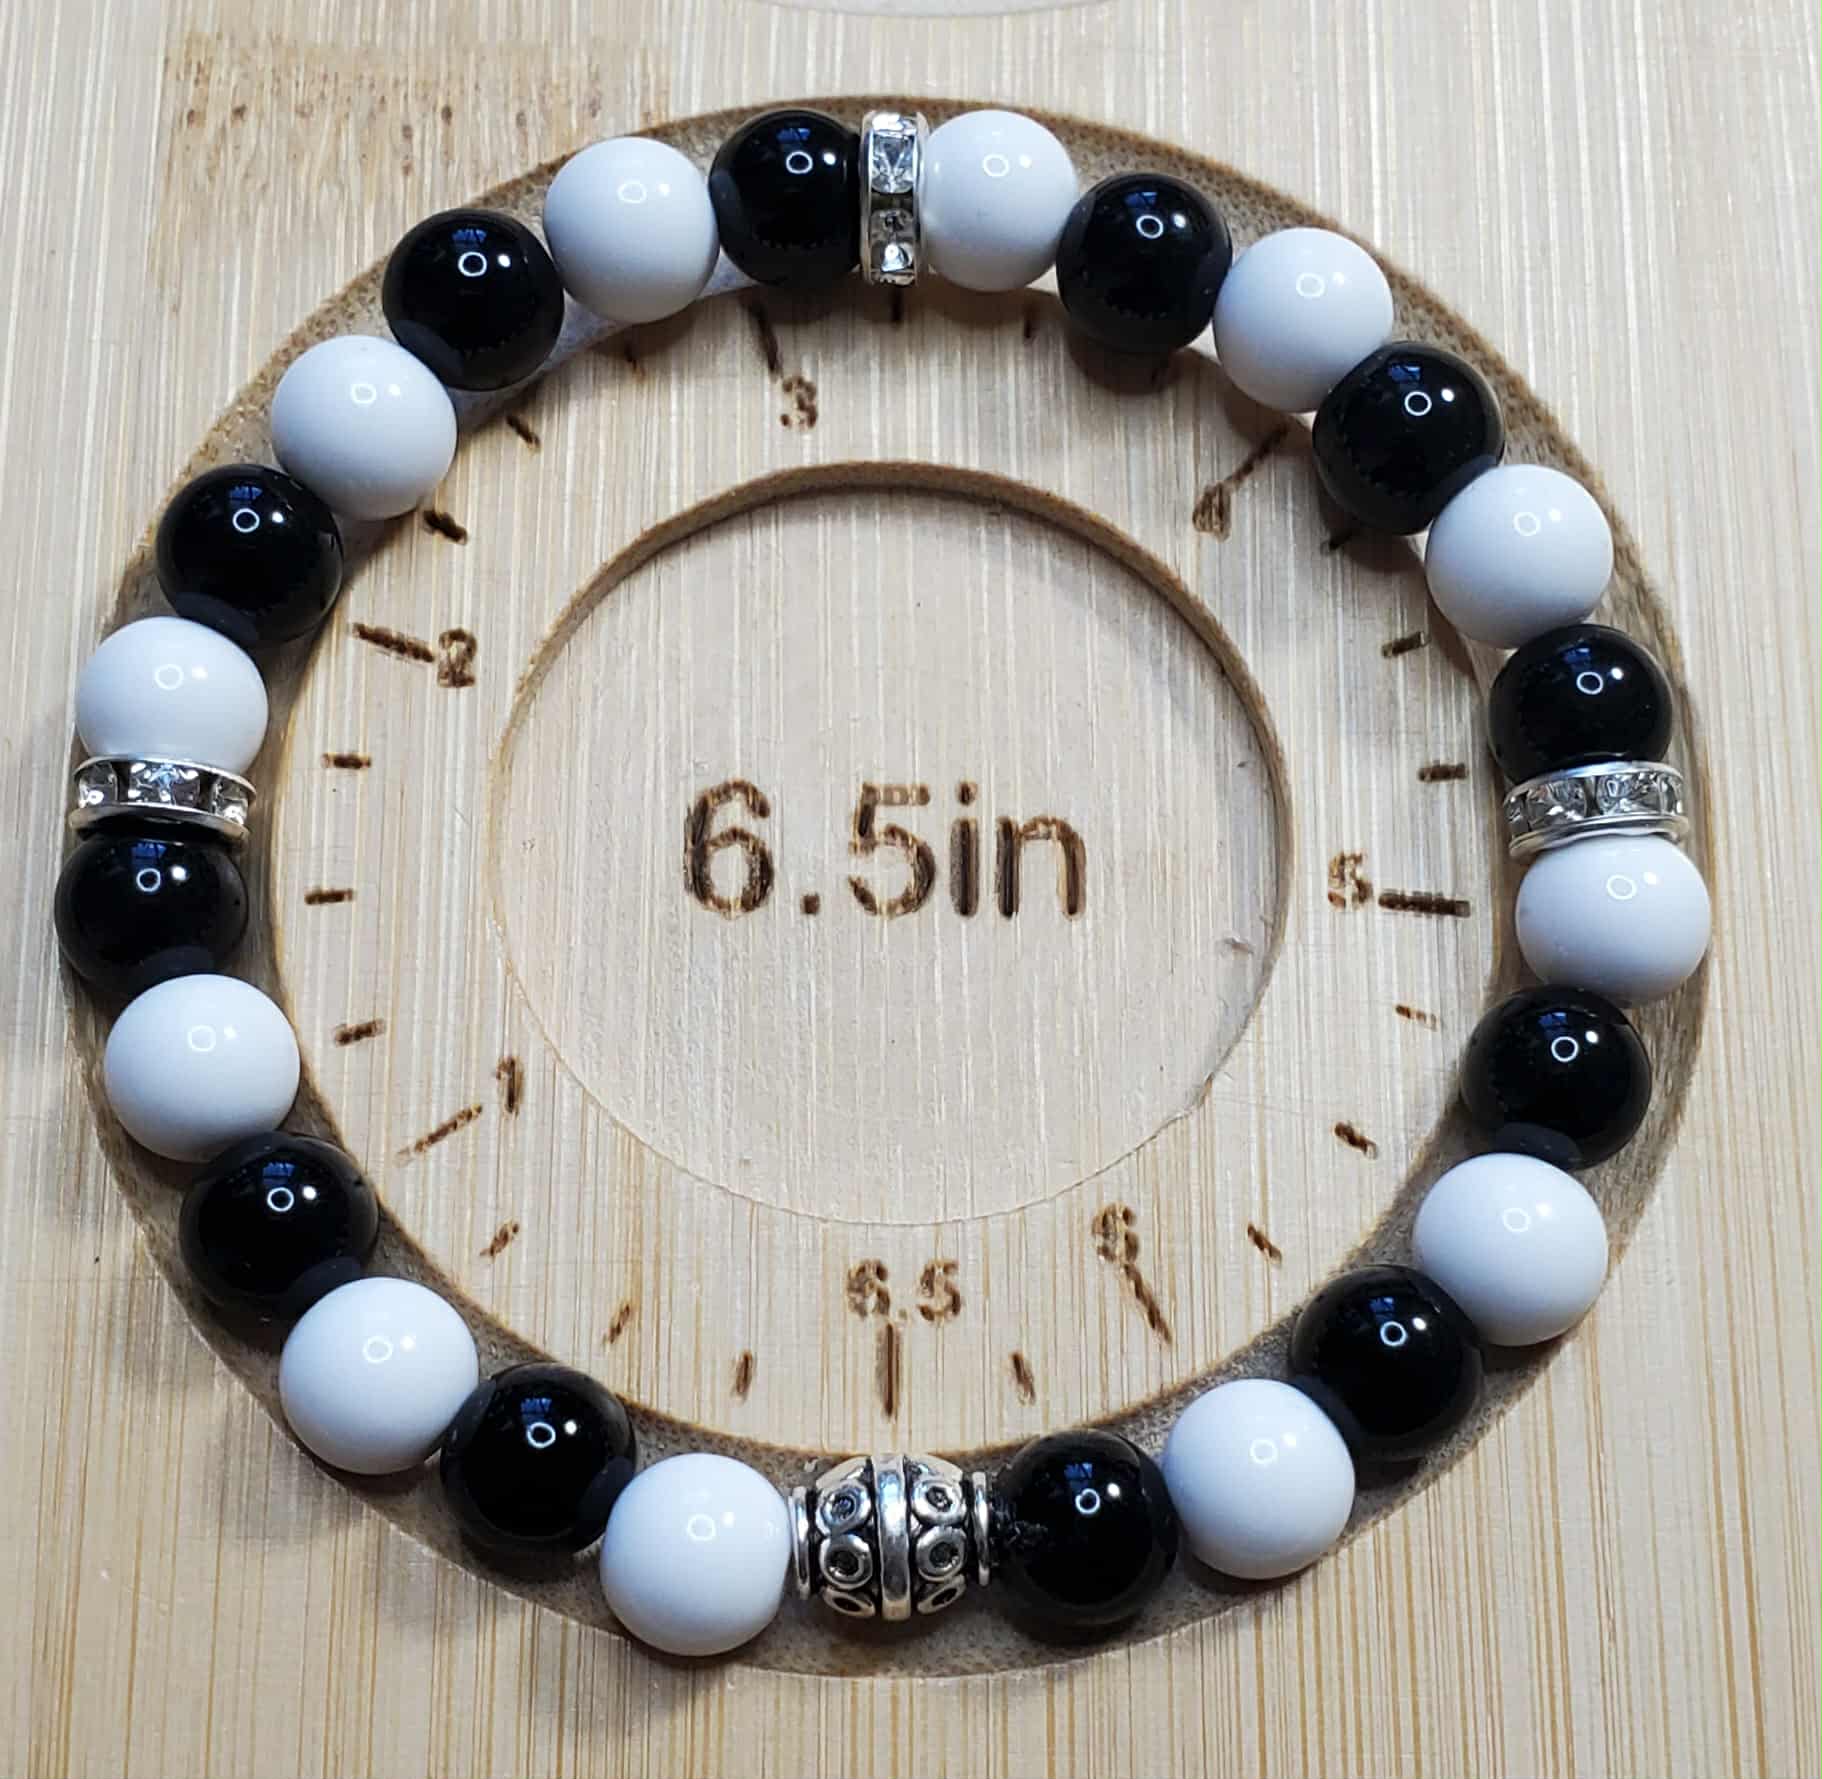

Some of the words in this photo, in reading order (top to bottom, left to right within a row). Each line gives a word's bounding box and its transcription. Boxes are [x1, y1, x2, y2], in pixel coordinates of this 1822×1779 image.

[780, 374, 819, 430] 3
[437, 627, 477, 689] 2
[682, 779, 1088, 921] 6.5in
[1327, 850, 1374, 910] 5
[495, 1054, 524, 1117] 1
[845, 1258, 962, 1323] 6.5
